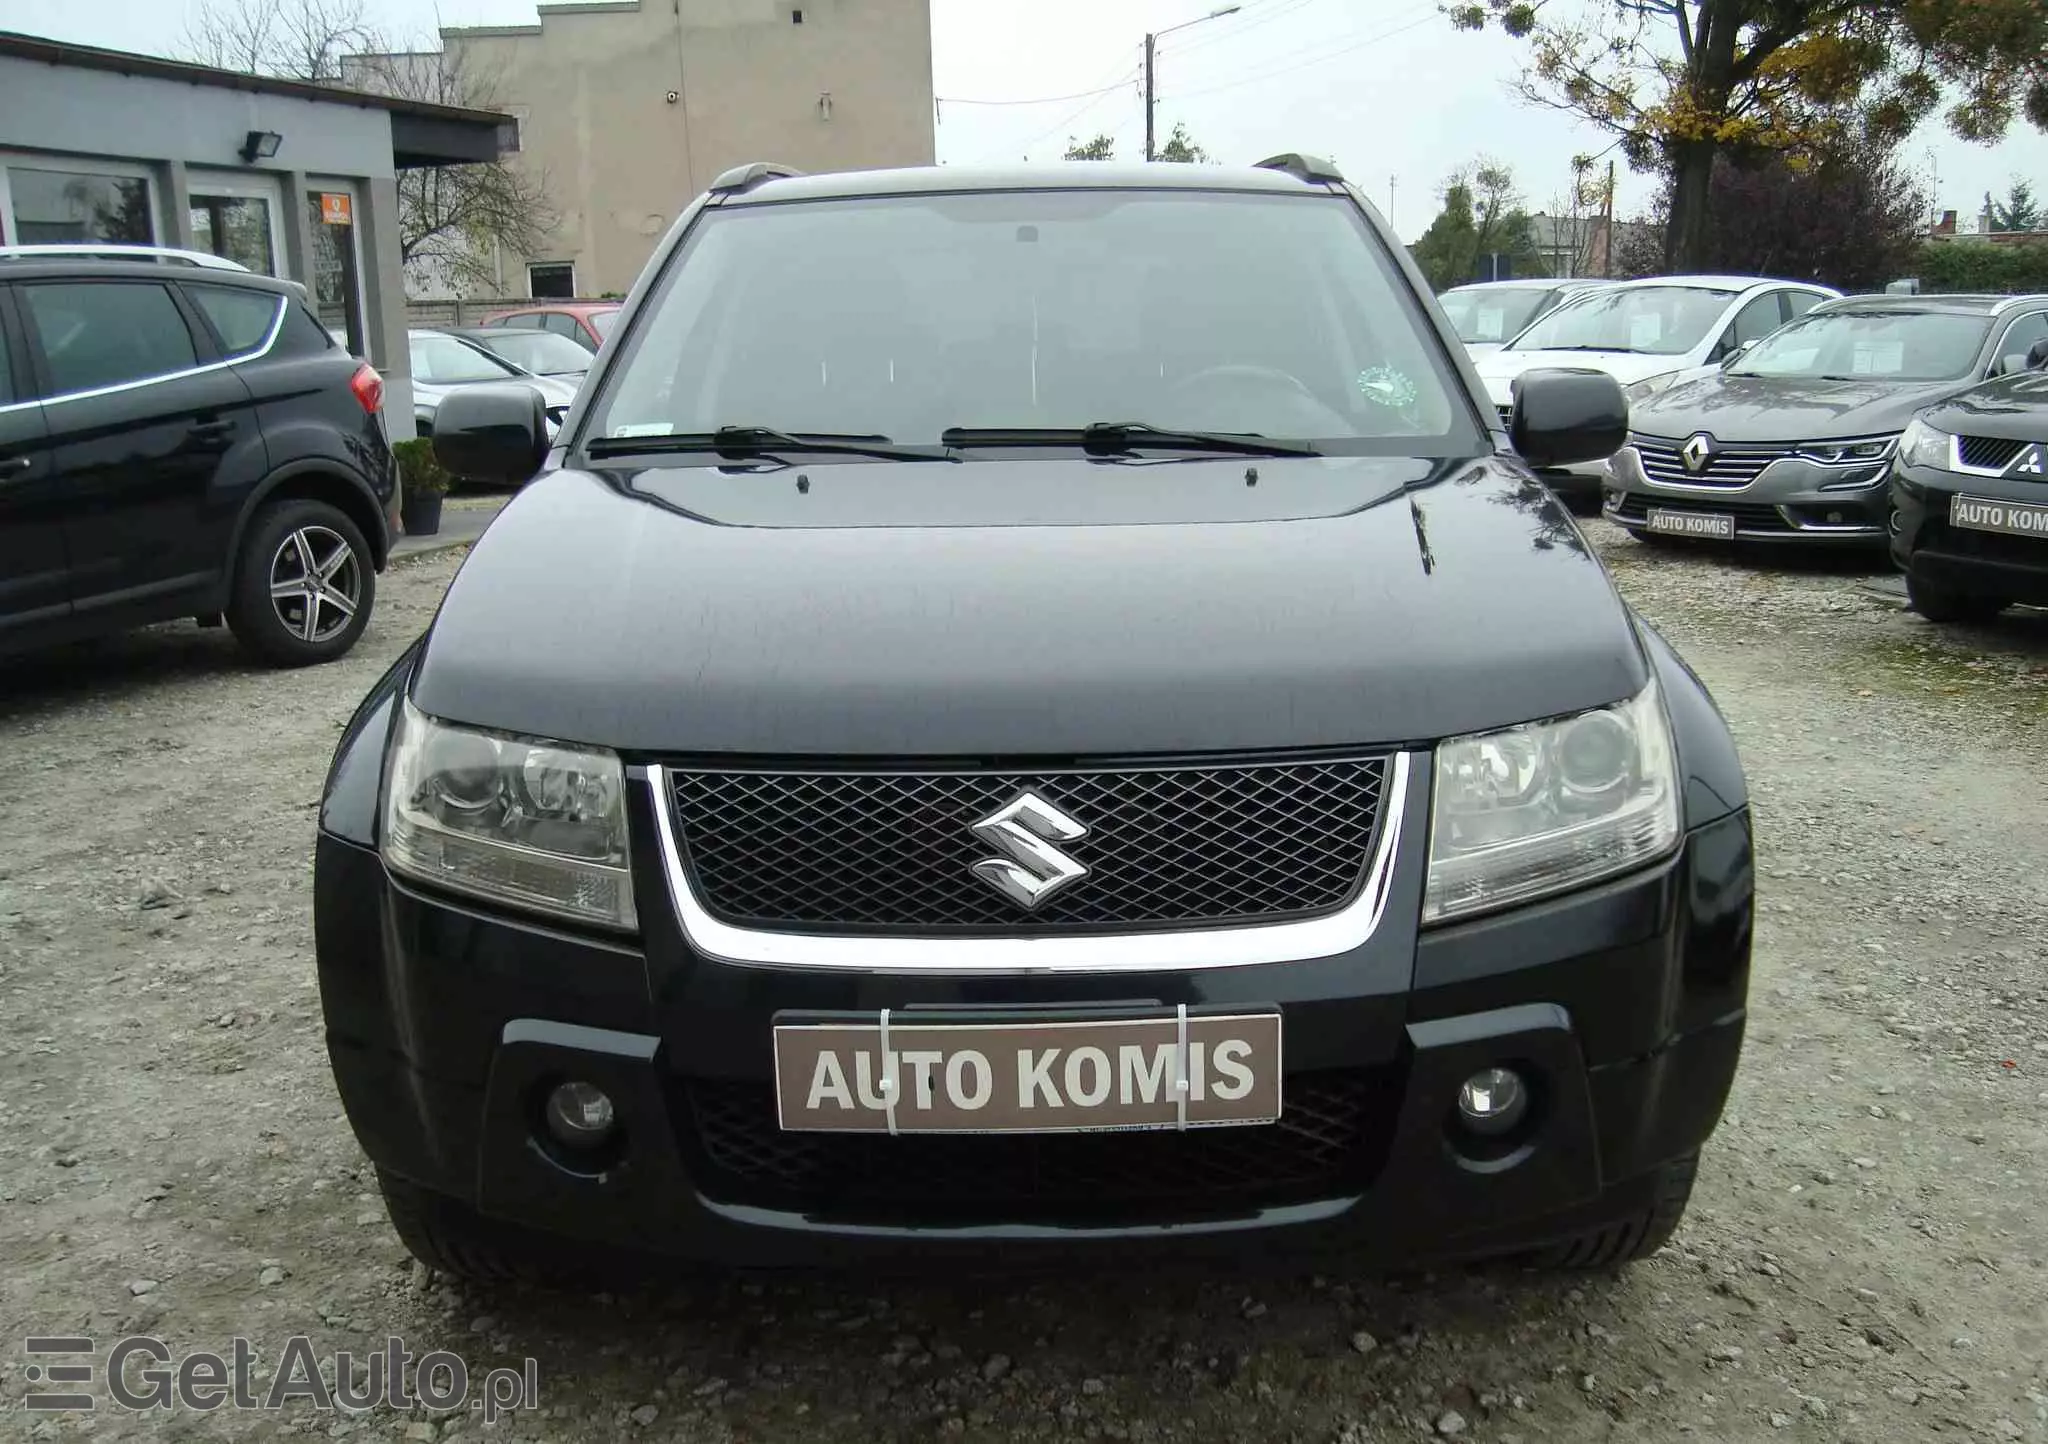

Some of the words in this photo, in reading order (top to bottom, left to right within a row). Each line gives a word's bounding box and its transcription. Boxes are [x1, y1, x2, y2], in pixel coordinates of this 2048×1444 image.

[1652, 514, 1684, 530] AUTO
[1687, 517, 1729, 535] KOMIS
[1958, 503, 2002, 526] AUTO
[805, 1049, 993, 1111] AUTO
[1017, 1039, 1255, 1109] KOMIS
